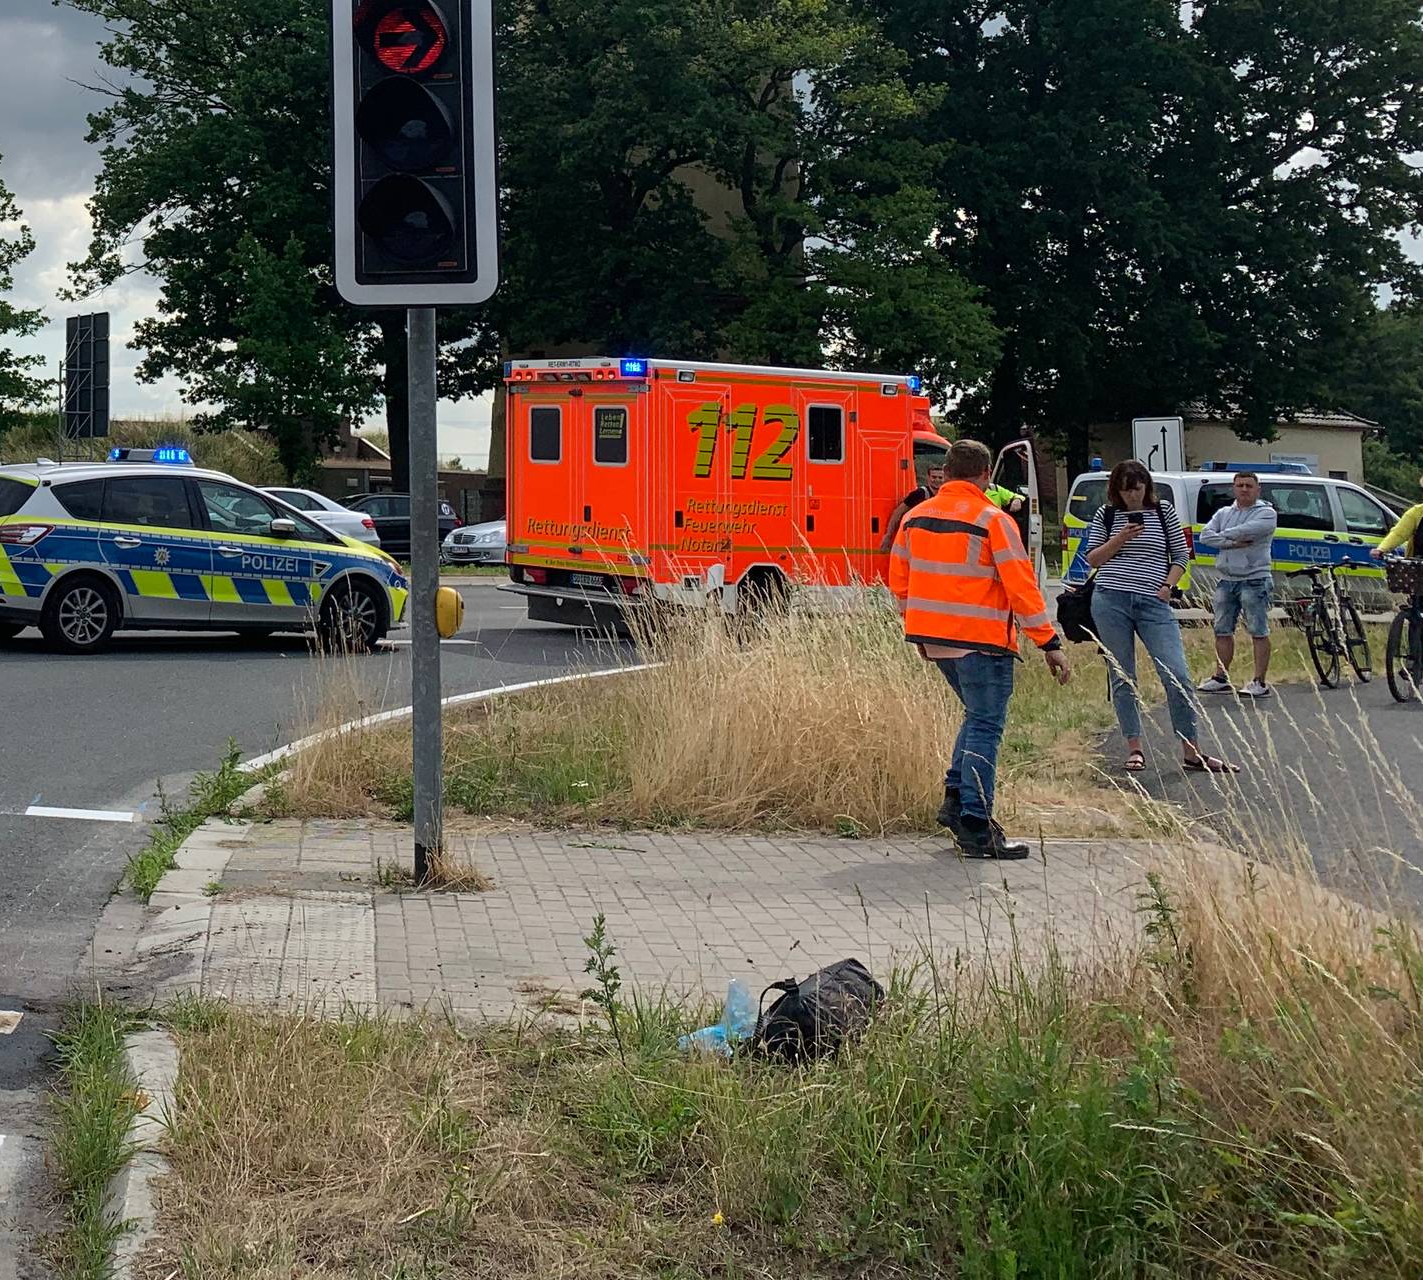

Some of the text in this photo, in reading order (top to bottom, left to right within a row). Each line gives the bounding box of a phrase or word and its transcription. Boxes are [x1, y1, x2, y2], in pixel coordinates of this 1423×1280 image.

[687, 402, 800, 481] 112
[687, 499, 788, 518] Rettungsdienst
[527, 519, 631, 542] Rettungsdienst
[683, 518, 758, 534] Feuerwehr
[1289, 544, 1332, 560] POLIZEI
[241, 555, 298, 573] POLIZEI
